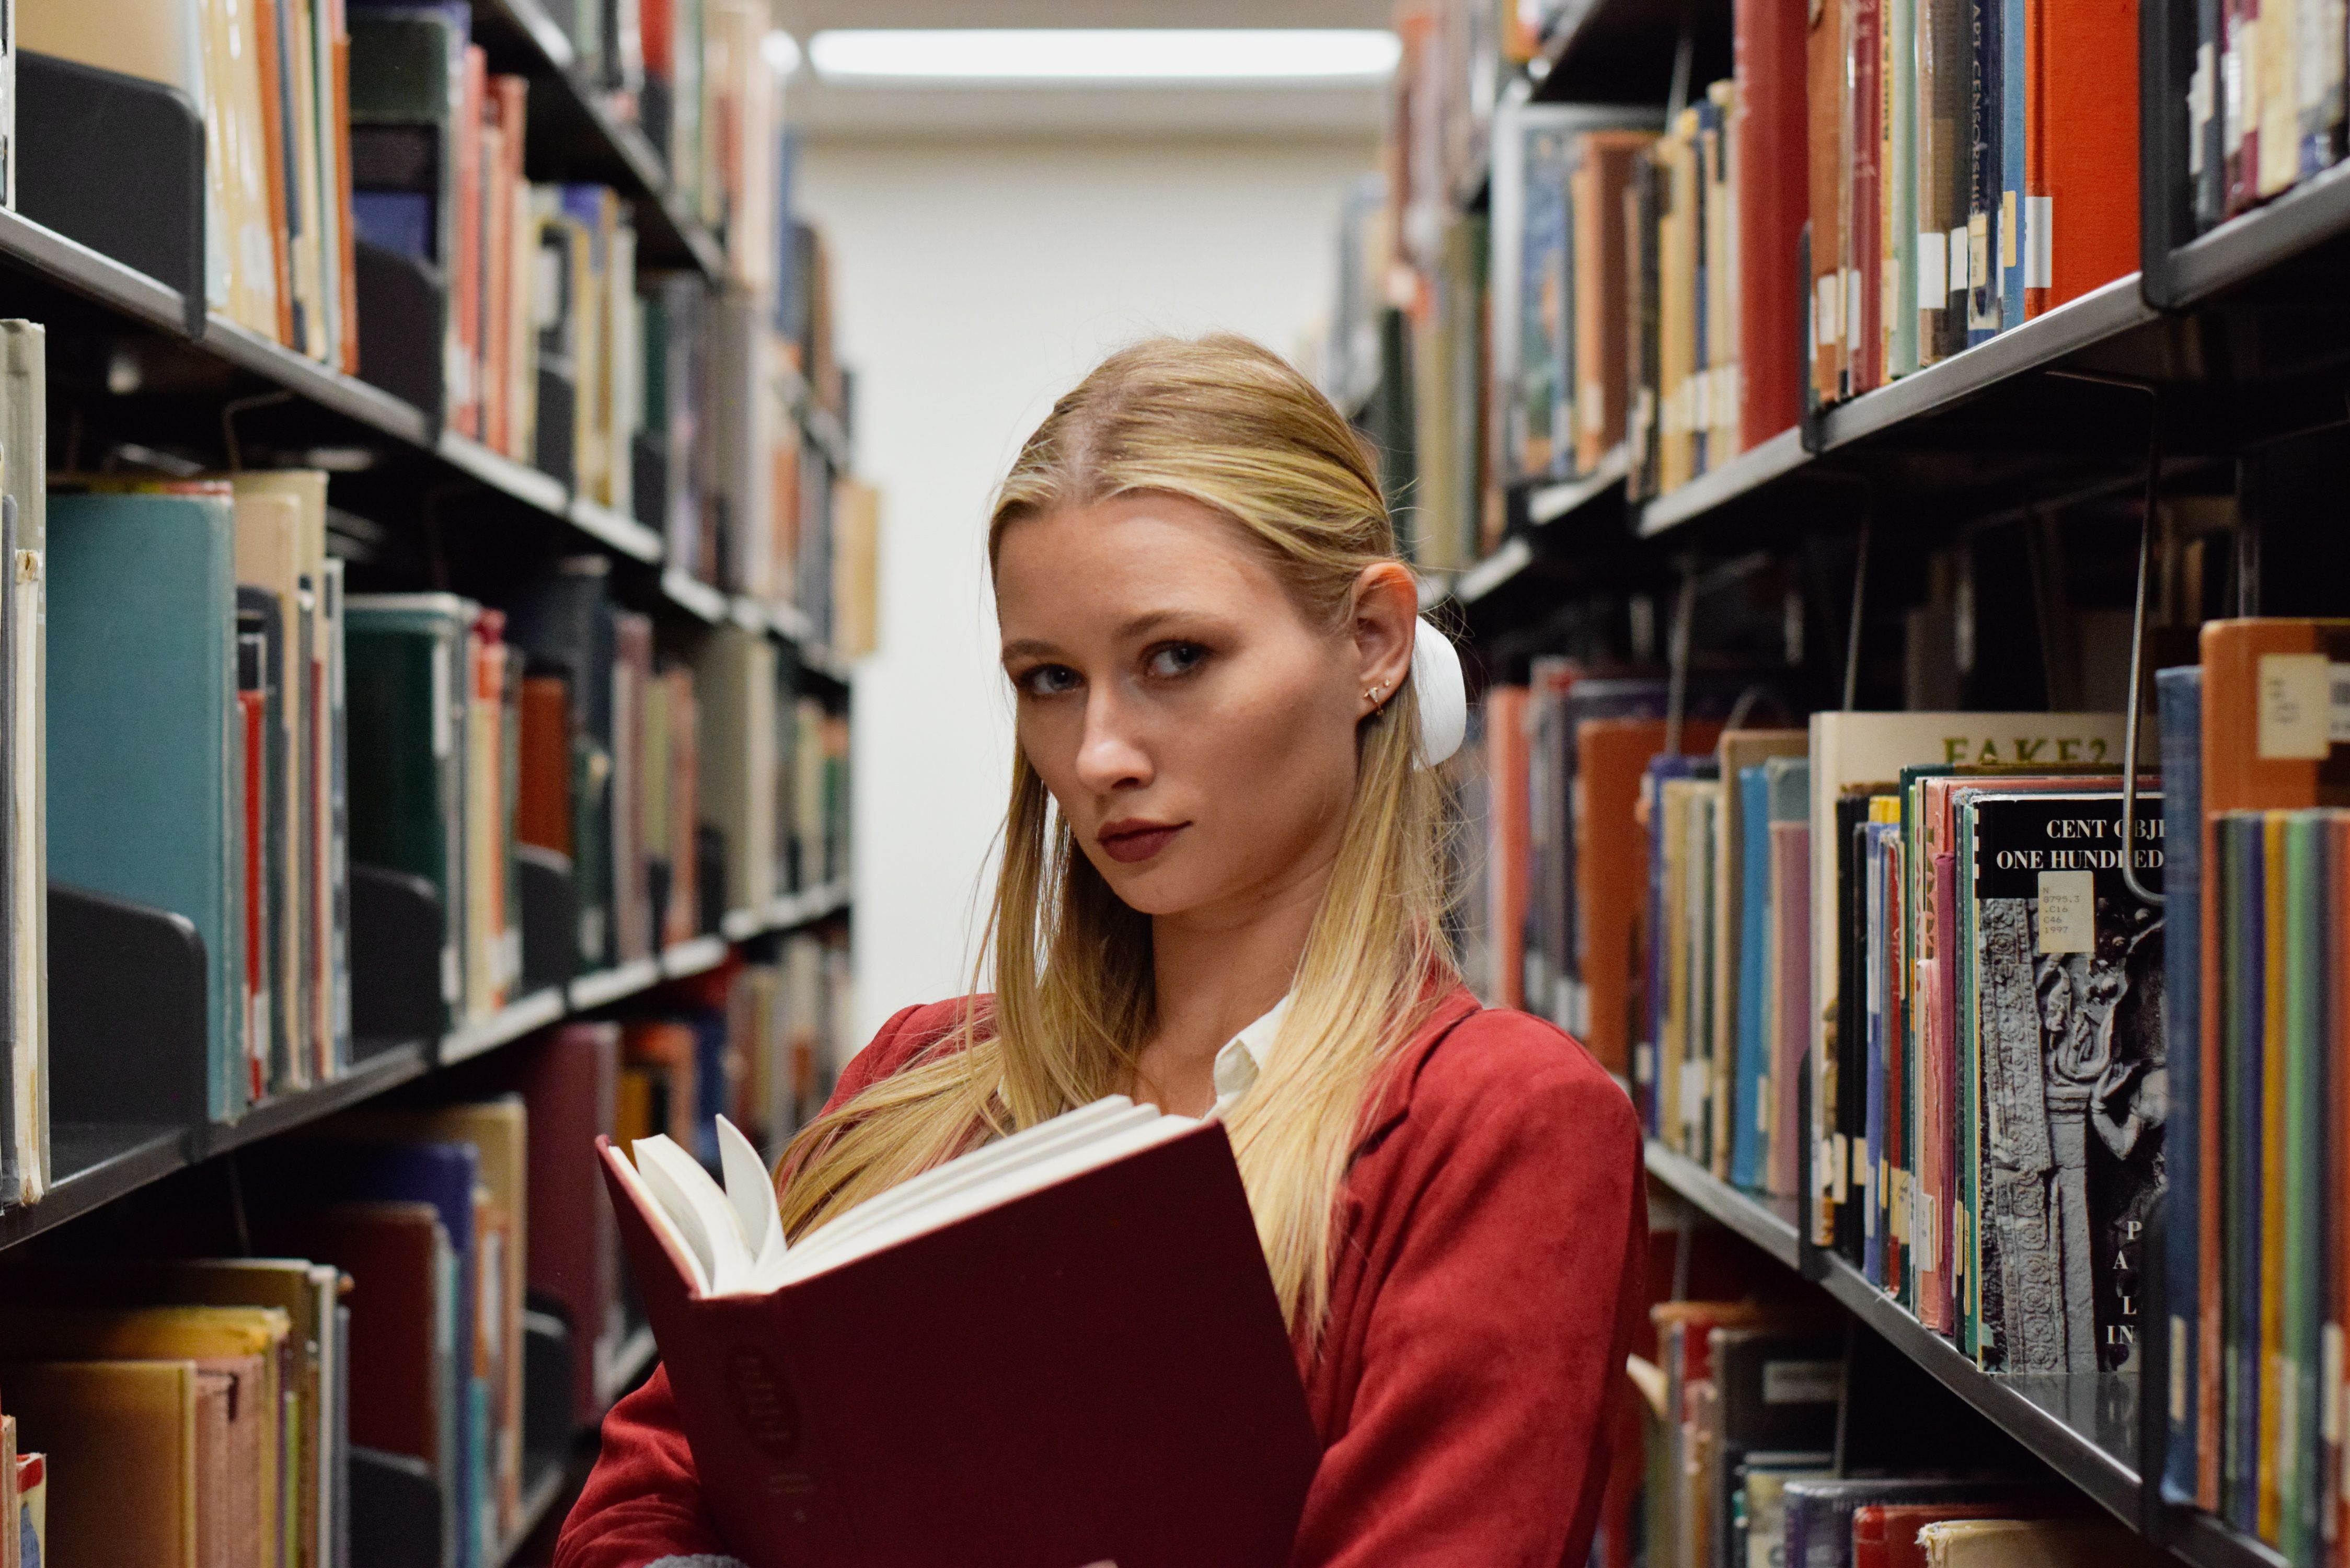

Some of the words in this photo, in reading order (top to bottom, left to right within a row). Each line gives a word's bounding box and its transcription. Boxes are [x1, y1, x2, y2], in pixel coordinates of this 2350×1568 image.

[2046, 819, 2107, 838] CENT
[1996, 850, 2043, 869] ONE
[2106, 1325, 2135, 1344] IN
